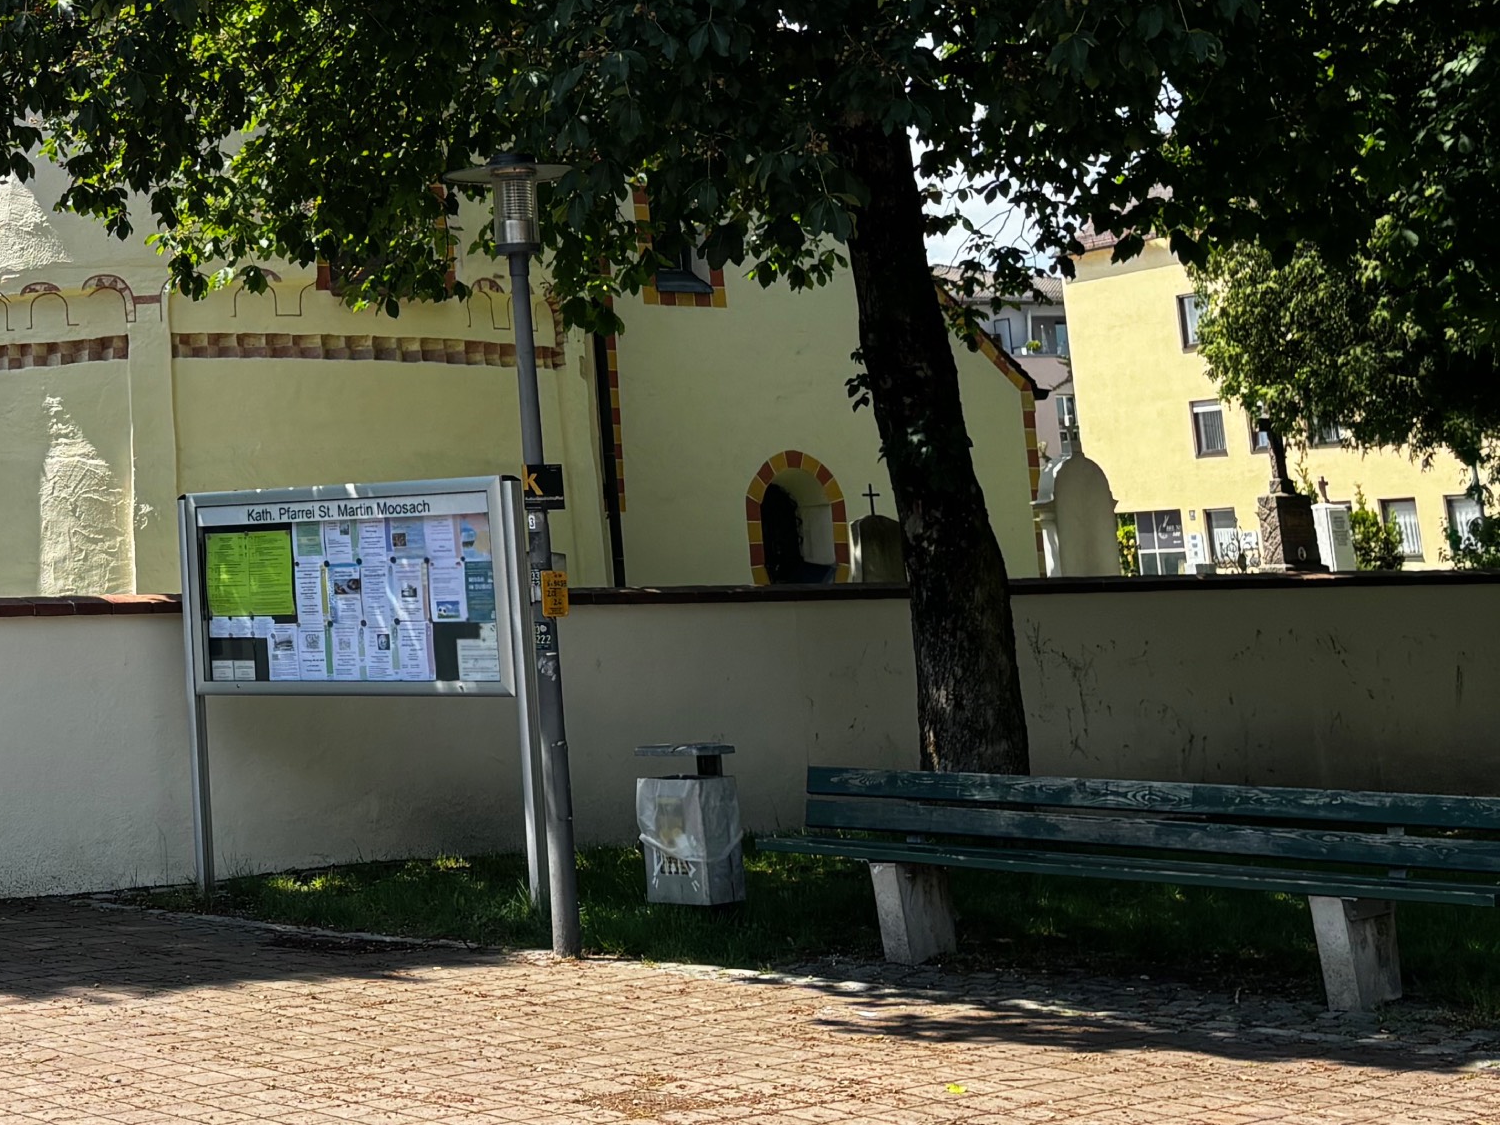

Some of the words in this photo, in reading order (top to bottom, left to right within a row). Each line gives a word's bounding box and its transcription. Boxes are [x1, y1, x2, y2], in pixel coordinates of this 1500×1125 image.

[247, 508, 275, 522] Kath.
[279, 505, 315, 521] Pfarrei
[318, 504, 334, 519] St.
[338, 502, 374, 518] Martin
[376, 500, 431, 516] Moosach
